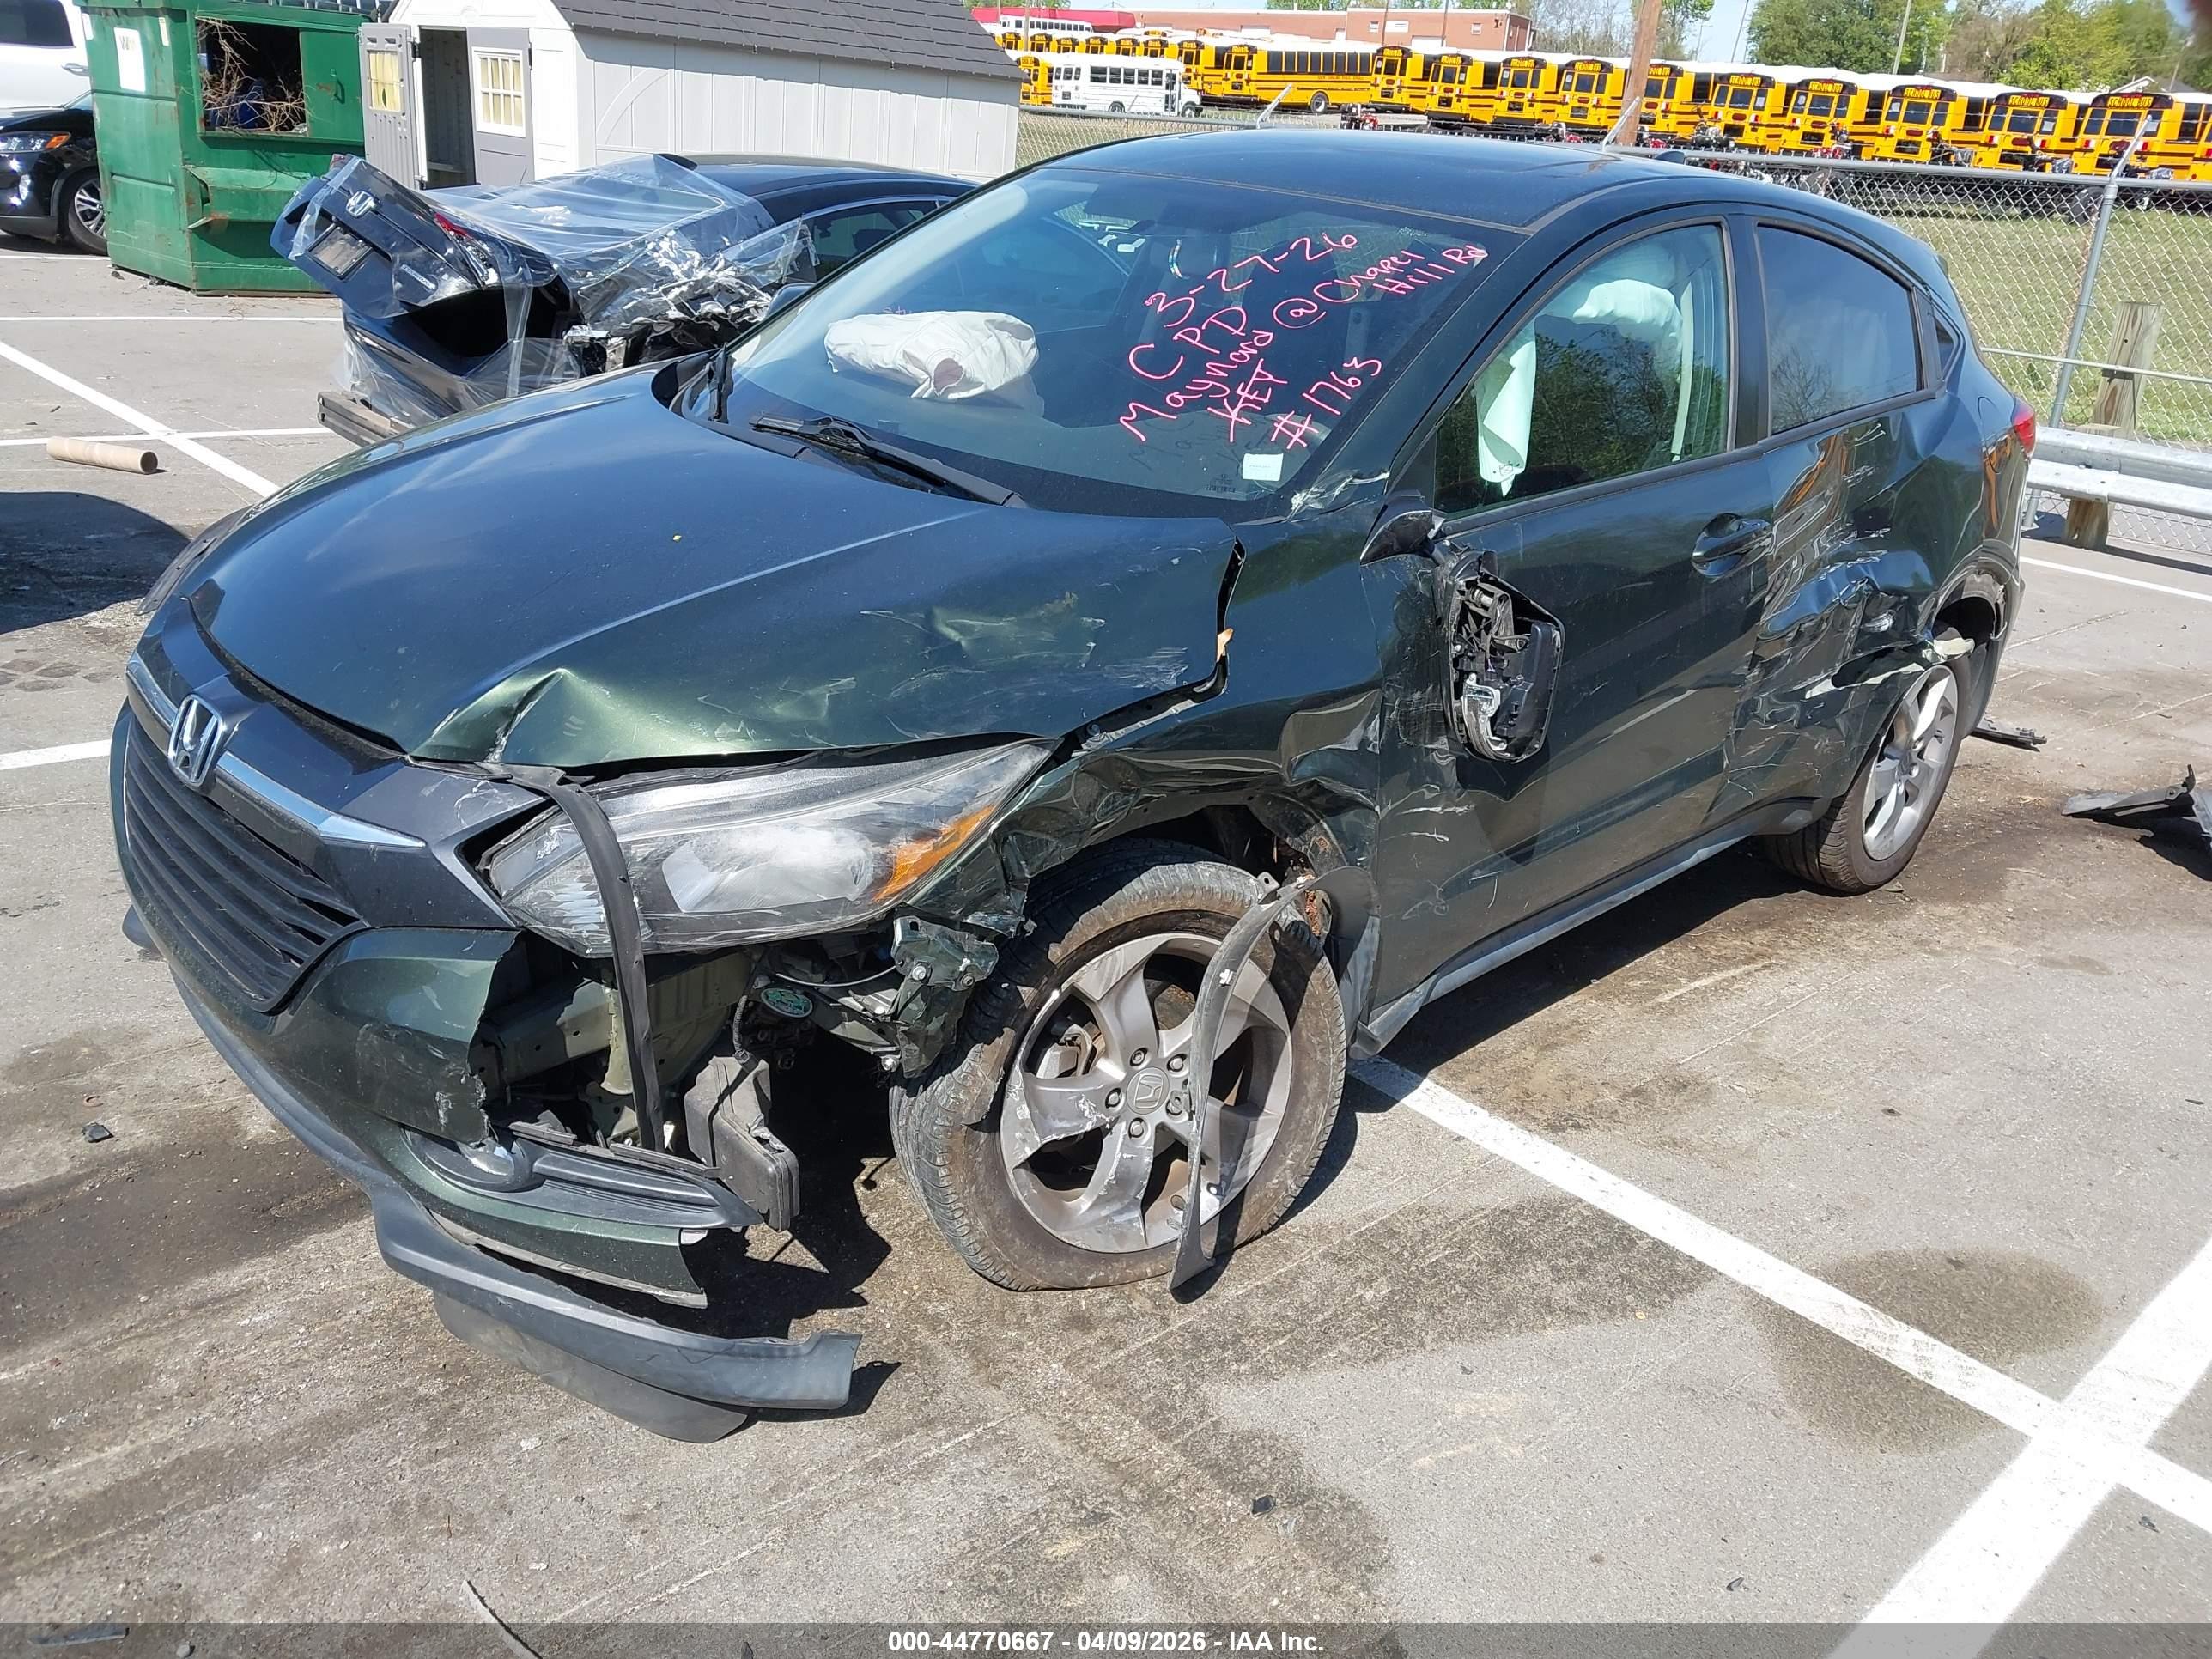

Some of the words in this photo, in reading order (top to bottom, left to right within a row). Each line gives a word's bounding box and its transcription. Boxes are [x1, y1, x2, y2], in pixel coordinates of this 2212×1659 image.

[1145, 233, 1358, 328] 3-27-26
[1373, 263, 1455, 294] Hill
[1442, 244, 1489, 264] Rd
[1273, 298, 1327, 329] @
